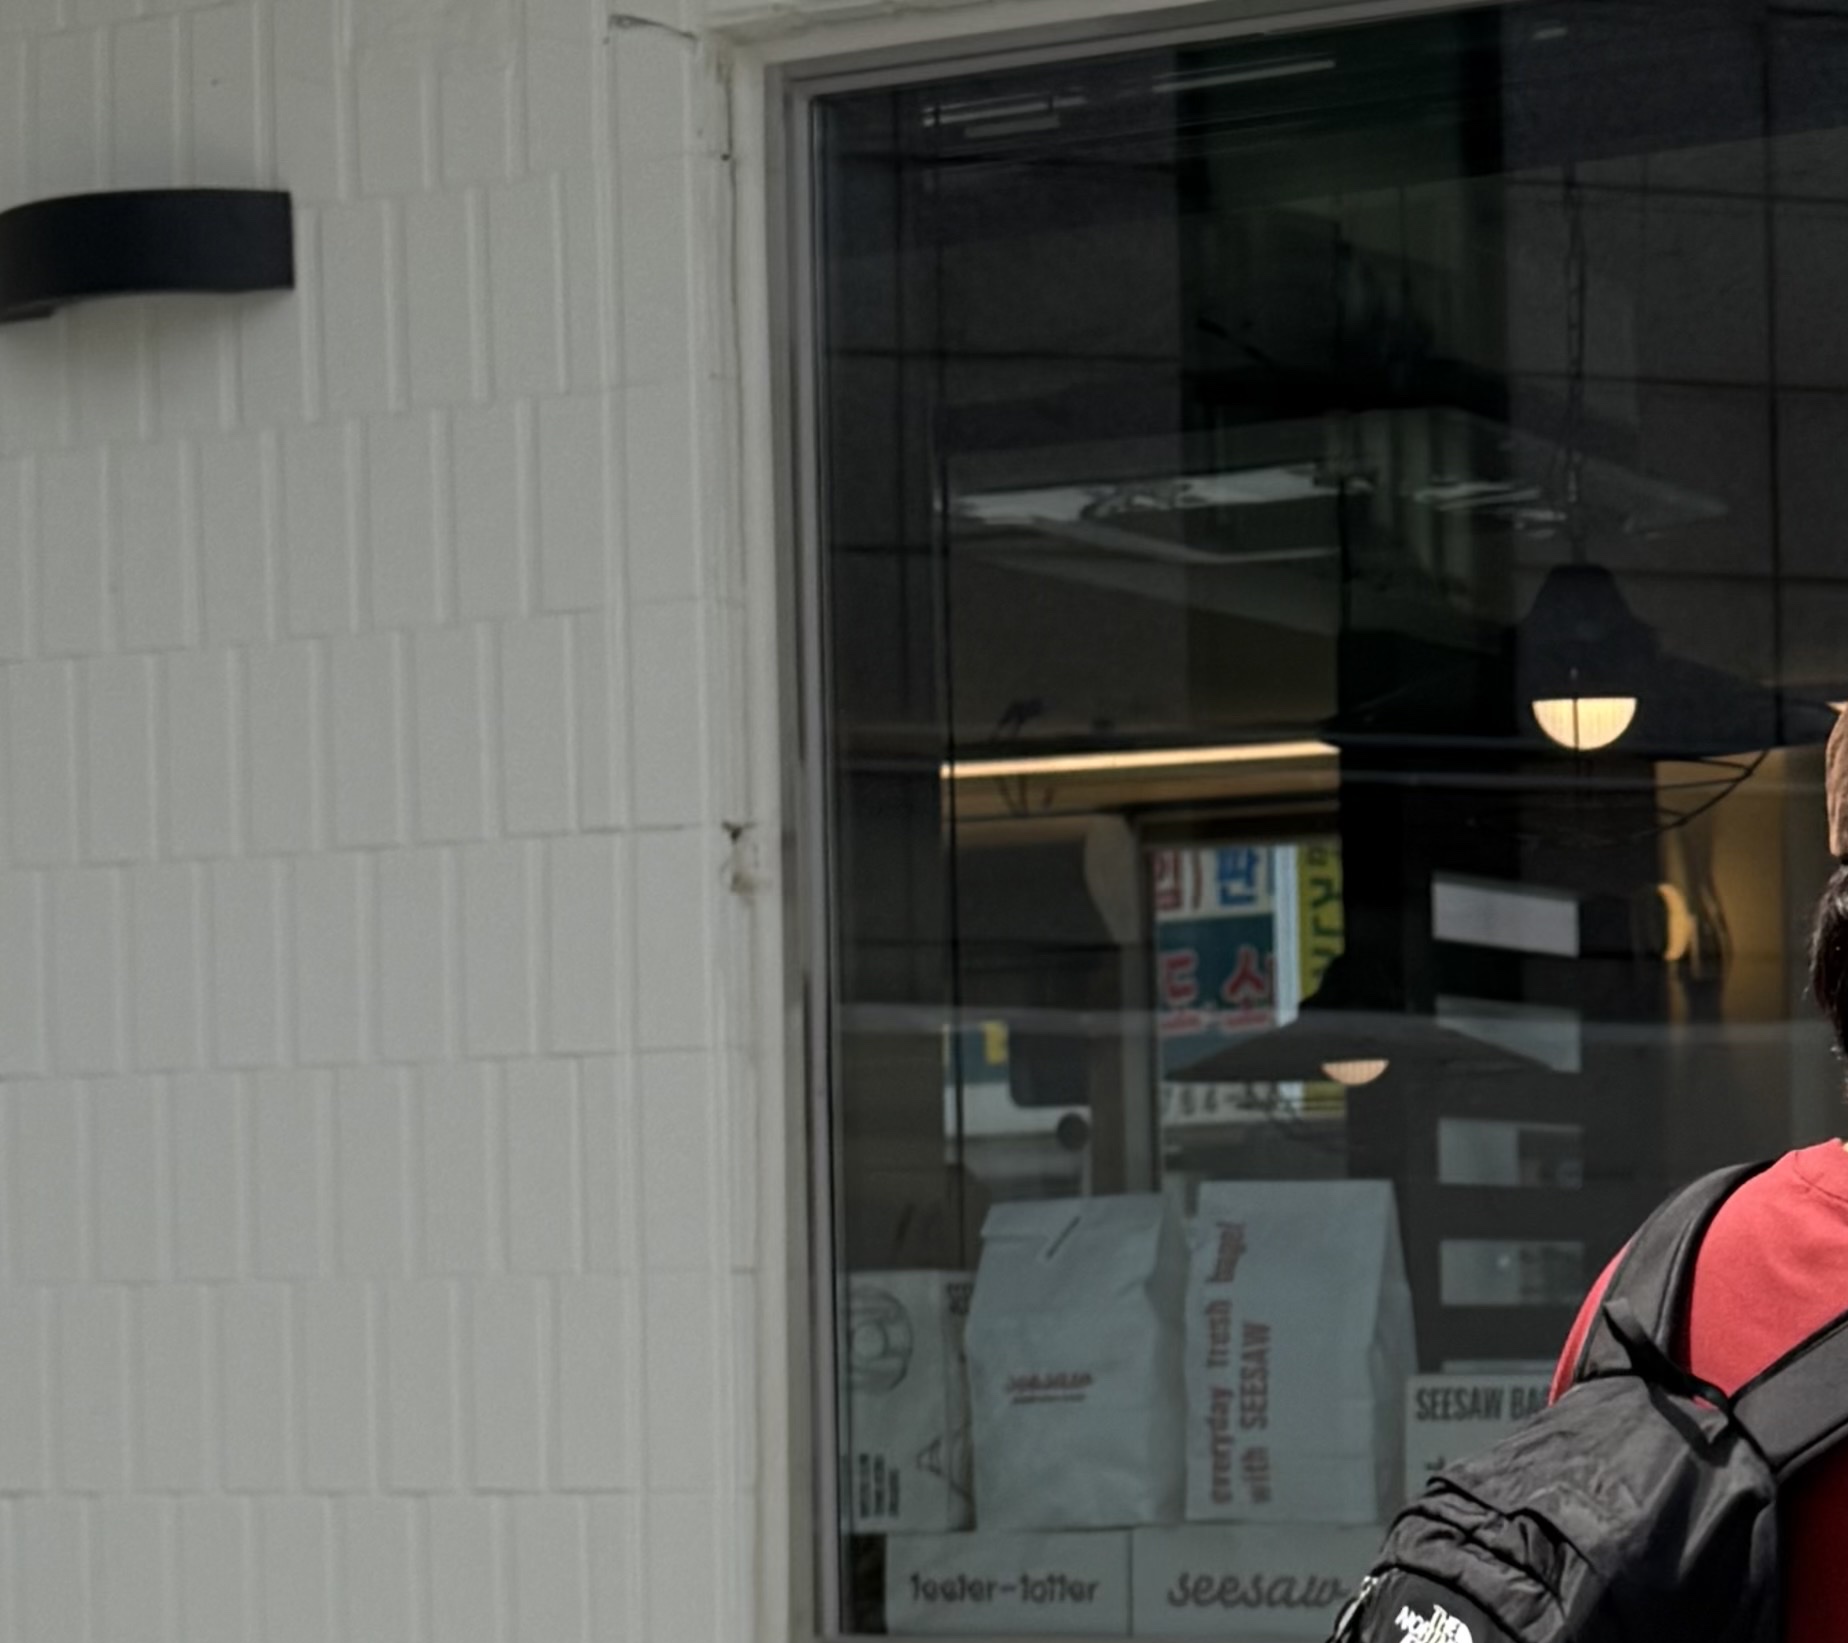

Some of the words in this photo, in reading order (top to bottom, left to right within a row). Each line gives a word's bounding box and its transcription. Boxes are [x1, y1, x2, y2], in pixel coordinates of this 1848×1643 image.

[1205, 1300, 1232, 1368] fresh
[1241, 1321, 1271, 1430] SEESAW
[1416, 1385, 1504, 1421] SEESAW
[1205, 1385, 1234, 1504] everyday
[1242, 1447, 1270, 1504] with
[910, 1570, 1099, 1604] teeter-totter
[1167, 1570, 1350, 1609] seesaw
[1430, 1603, 1461, 1637] THE
